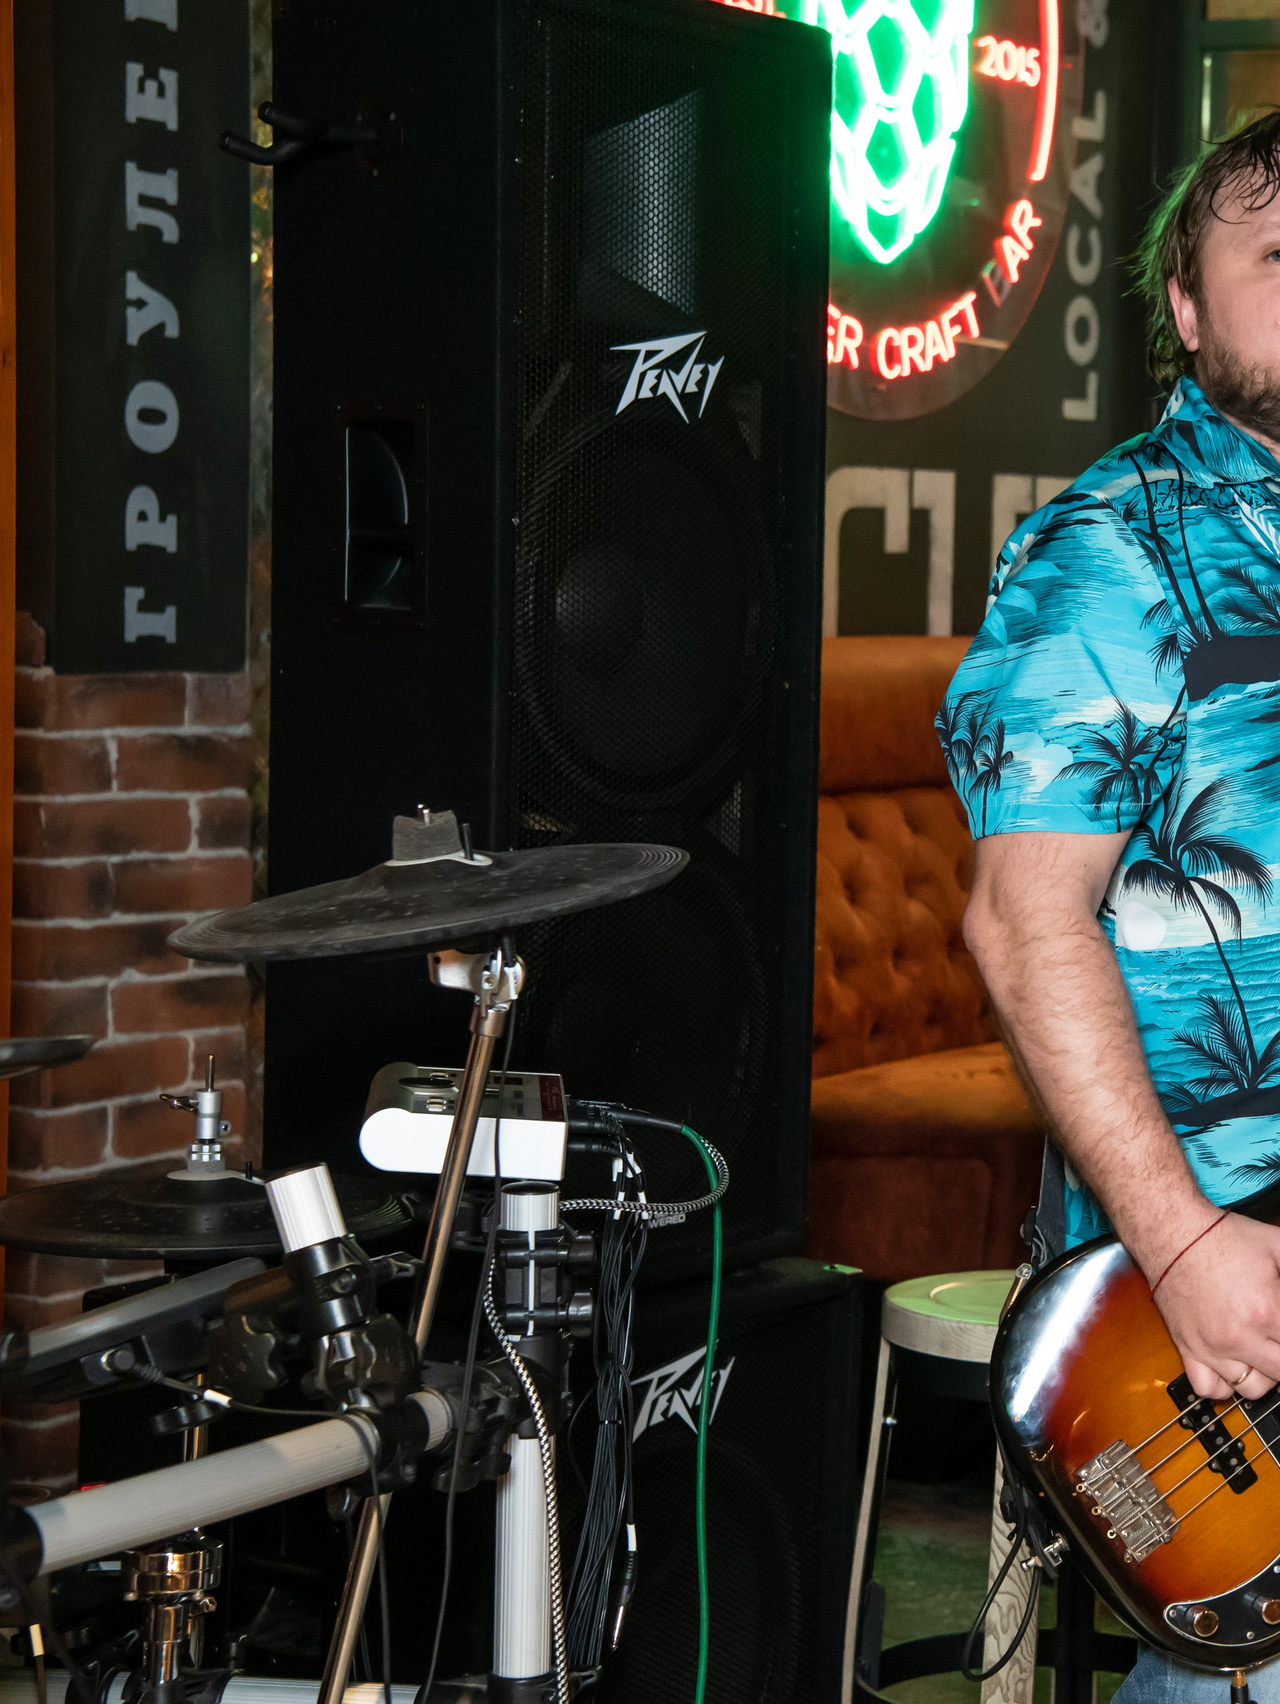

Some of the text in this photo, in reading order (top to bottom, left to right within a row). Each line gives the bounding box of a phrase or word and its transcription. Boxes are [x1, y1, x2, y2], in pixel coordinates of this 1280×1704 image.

[976, 35, 1041, 87] 2015
[1062, 90, 1107, 421] LOCAL
[609, 330, 725, 424] PEAVEY
[876, 290, 980, 380] CRAFT
[639, 1213, 686, 1230] WERED
